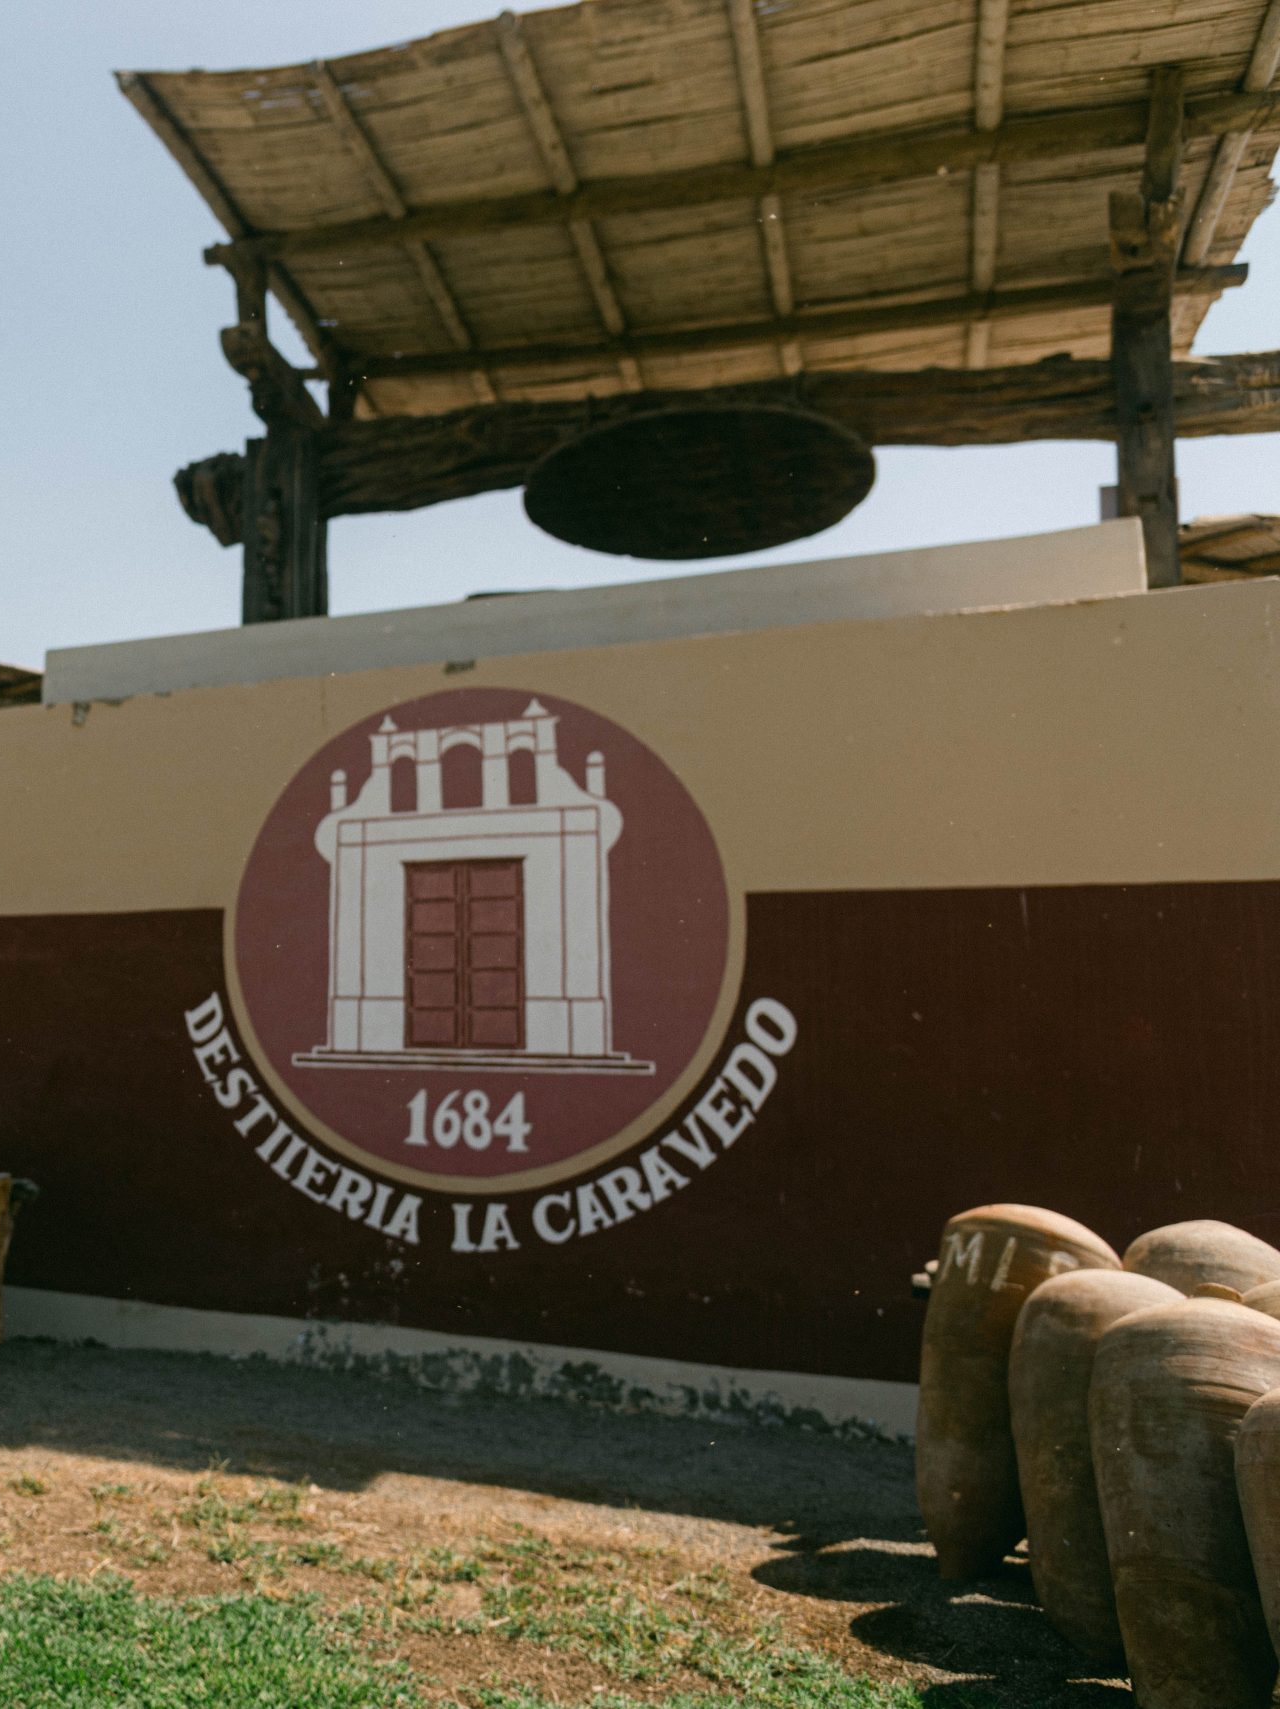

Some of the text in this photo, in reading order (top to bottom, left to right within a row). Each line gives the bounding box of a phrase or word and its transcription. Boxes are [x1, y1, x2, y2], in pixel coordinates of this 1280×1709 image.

[403, 1088, 532, 1153] 1684
[451, 1203, 521, 1252] LA
[532, 997, 797, 1244] CARAVEDO
